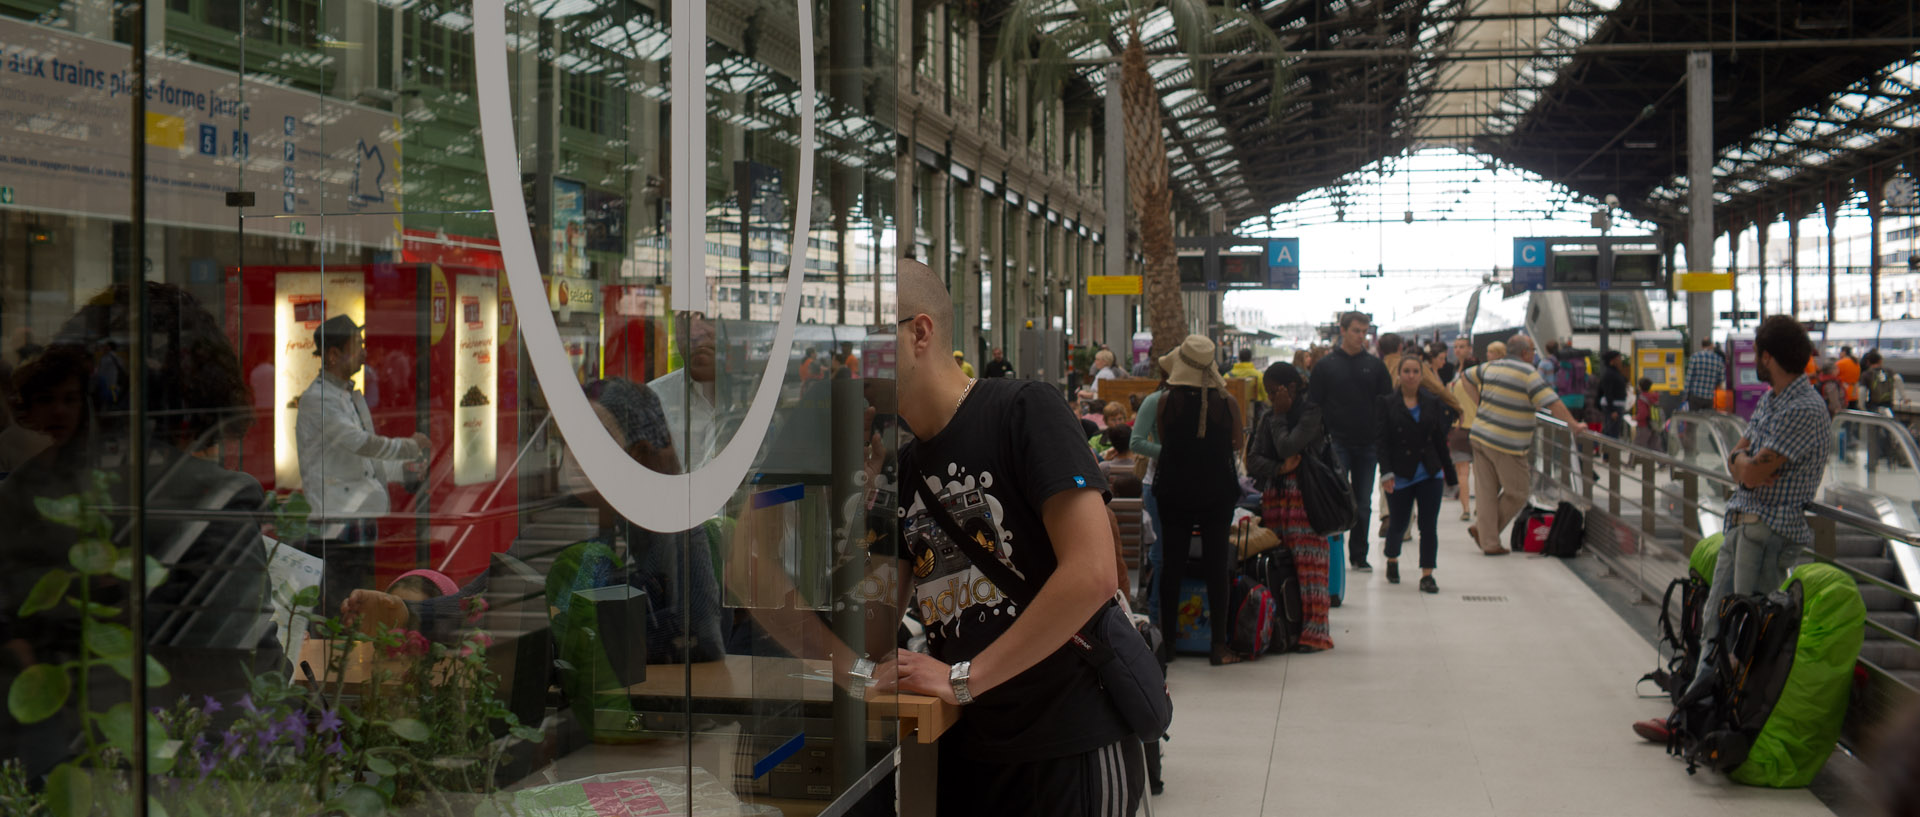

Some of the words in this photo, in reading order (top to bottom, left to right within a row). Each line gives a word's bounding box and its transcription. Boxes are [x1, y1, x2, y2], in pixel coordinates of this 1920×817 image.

[8, 53, 46, 79] aux
[52, 58, 105, 90] trains
[1277, 245, 1293, 263] A
[1522, 244, 1536, 264] C
[569, 287, 594, 304] selecta
